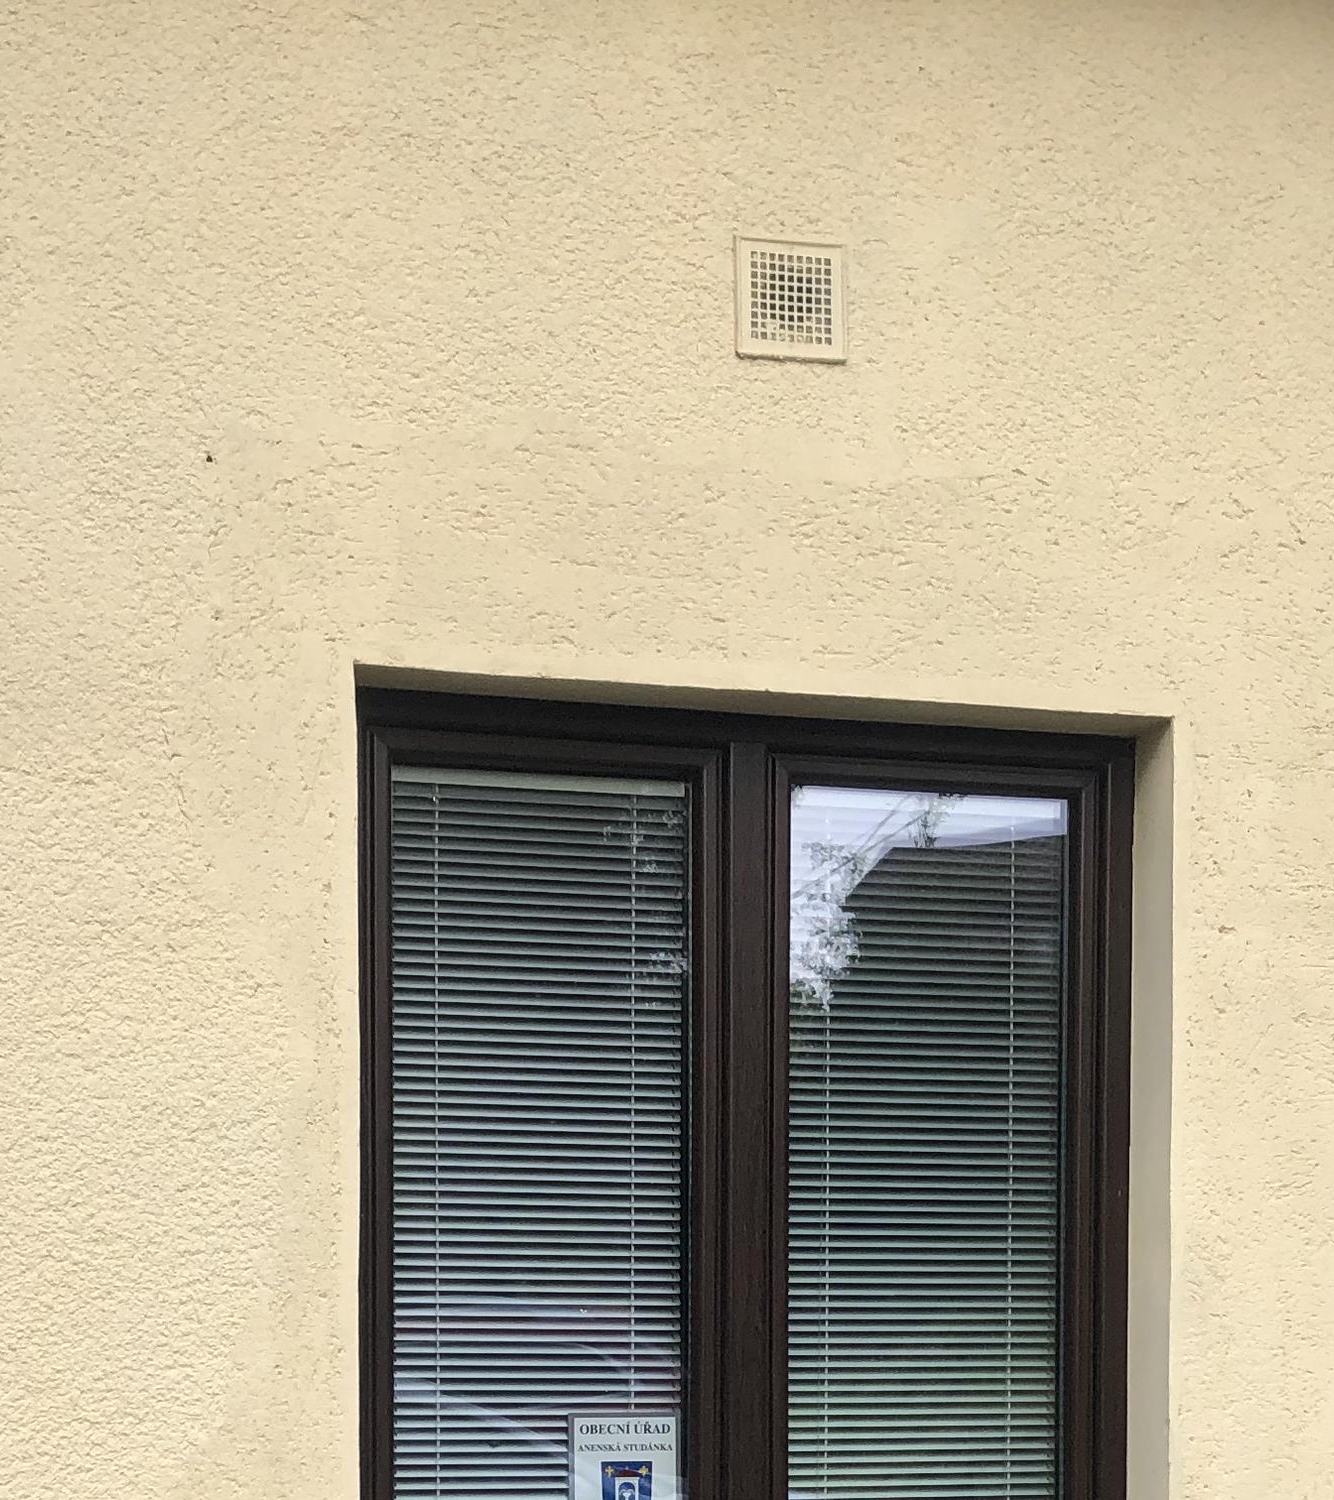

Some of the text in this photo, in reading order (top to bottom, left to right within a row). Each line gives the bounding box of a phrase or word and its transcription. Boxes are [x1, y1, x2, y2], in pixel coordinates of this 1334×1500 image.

[579, 1421, 671, 1435] OBECNÍ ÚŘAD
[578, 1442, 673, 1452] ANENSKÁ STUDÁNKA
